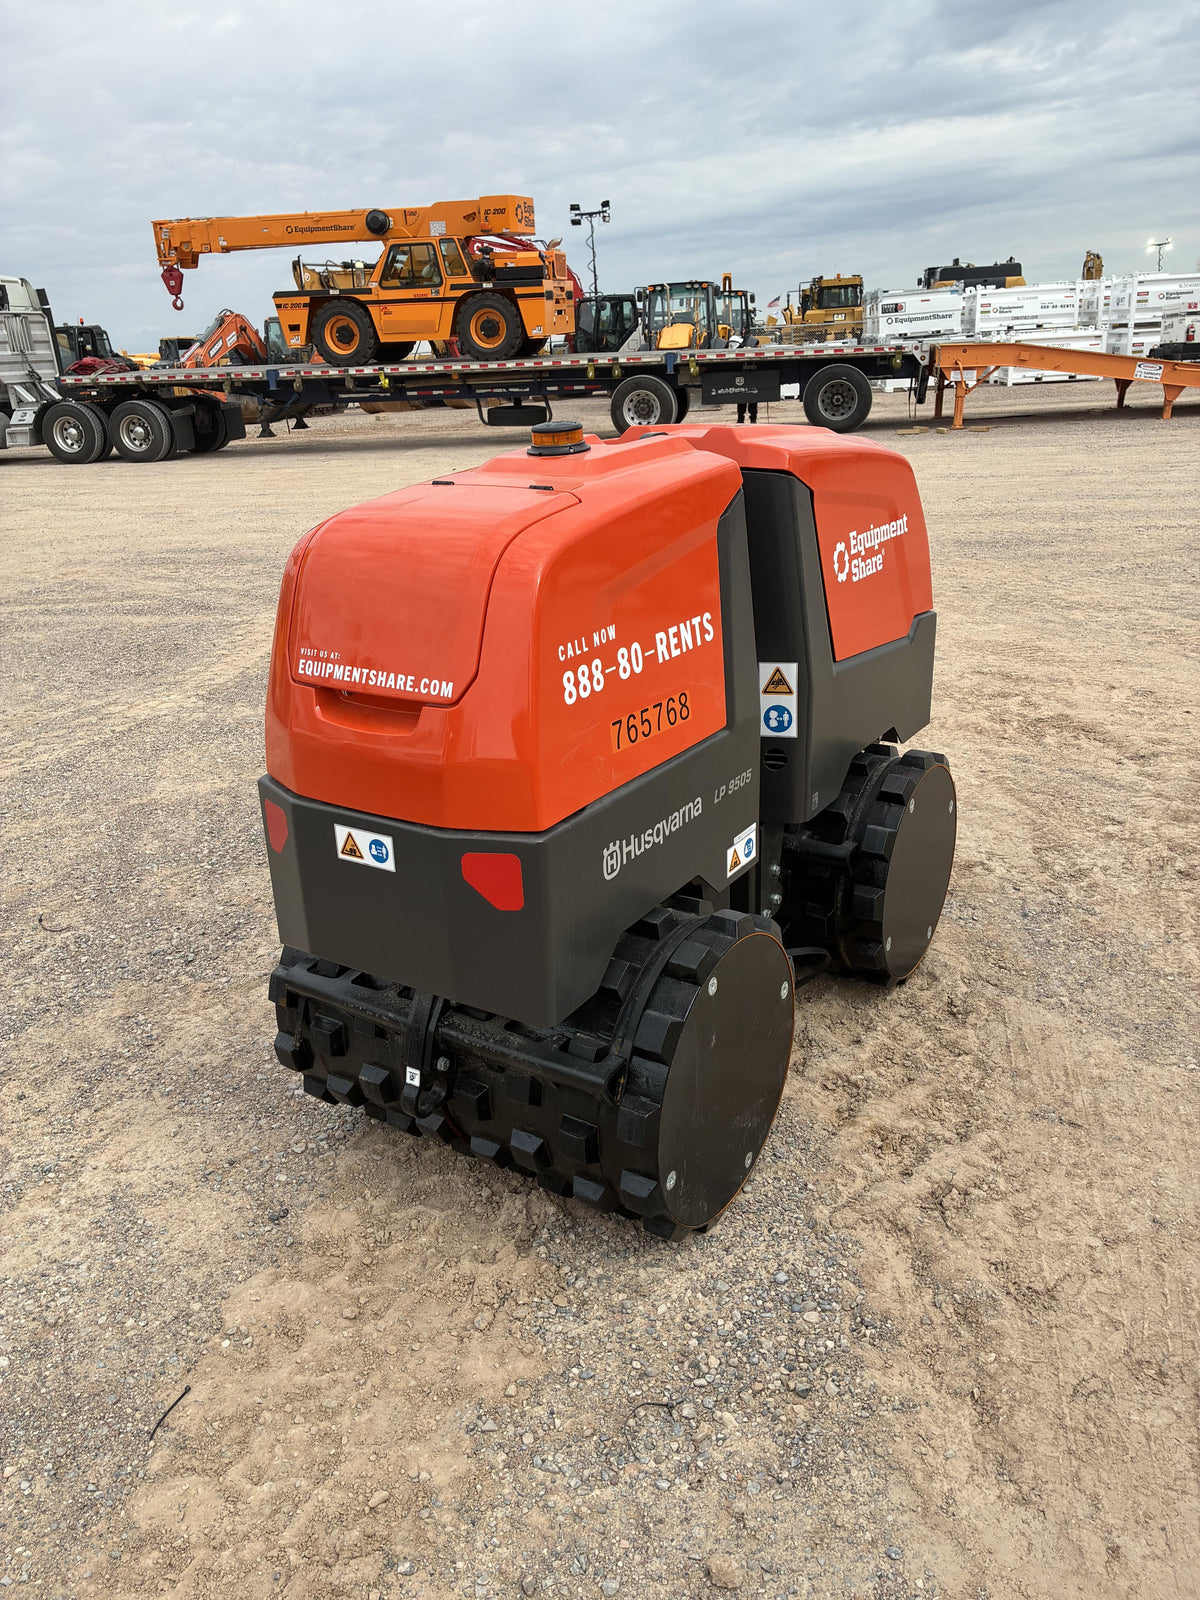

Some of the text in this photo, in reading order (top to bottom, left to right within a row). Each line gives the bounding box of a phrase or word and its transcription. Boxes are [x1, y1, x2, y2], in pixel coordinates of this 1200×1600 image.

[294, 224, 355, 234] EquipmentShare
[484, 208, 506, 216] IC-200
[894, 313, 953, 324] EquipmentShare
[849, 513, 908, 556] Equipment
[851, 553, 884, 583] Share
[300, 647, 341, 660] VISIT US AT:
[558, 623, 616, 662] CALL NOW
[562, 611, 715, 706] 888-80-RENTS
[298, 659, 454, 698] EQUIPMENTSHARE.COM
[611, 692, 690, 750] 765768
[714, 768, 753, 804] LP 9505
[622, 796, 703, 865] Husqvarna
